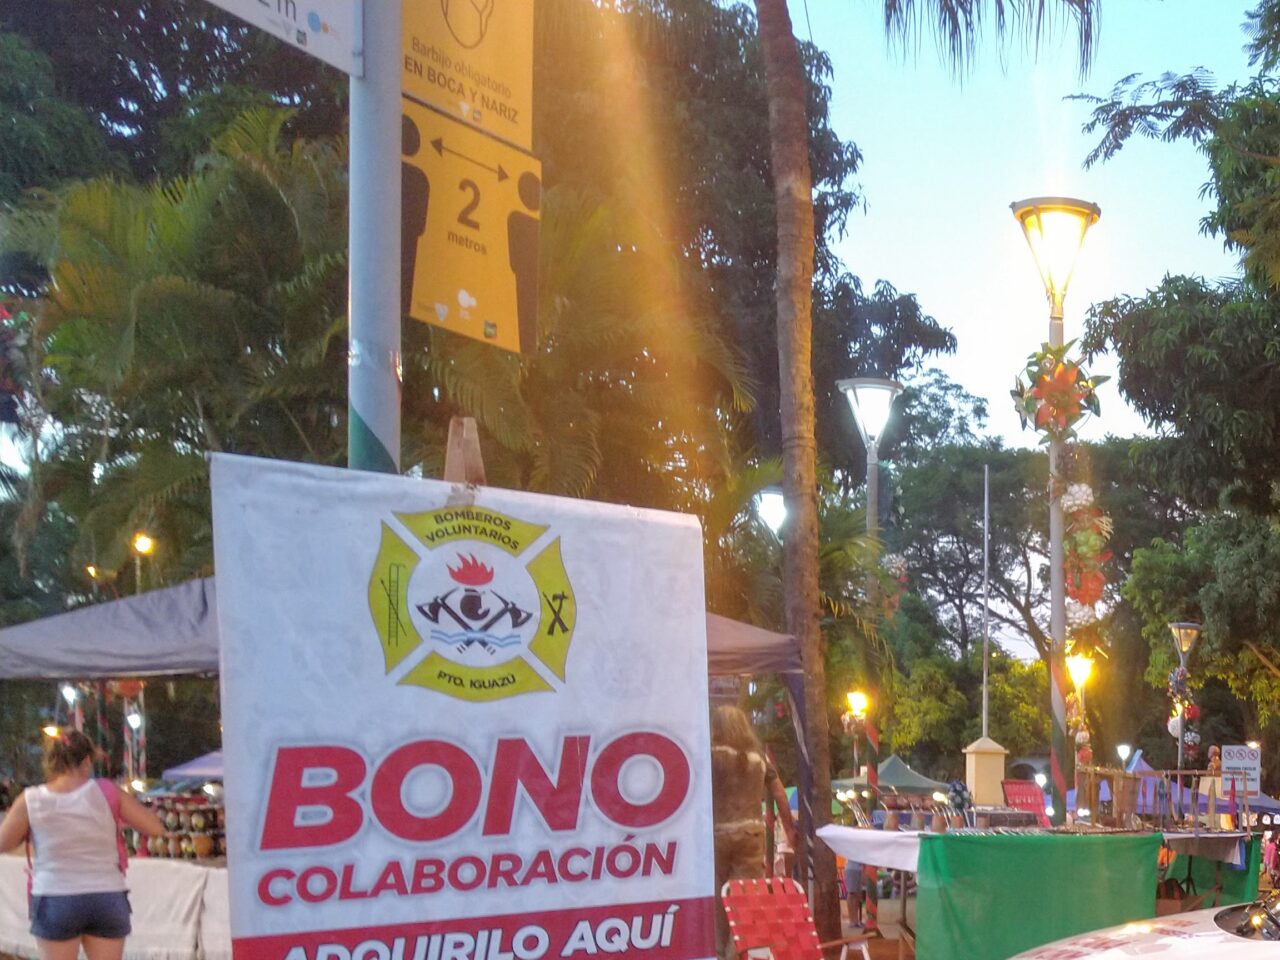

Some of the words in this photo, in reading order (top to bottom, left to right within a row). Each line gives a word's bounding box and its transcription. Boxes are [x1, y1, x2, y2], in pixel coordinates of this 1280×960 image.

[404, 54, 423, 78] EN
[427, 66, 466, 99] BOCA
[469, 86, 478, 103] Y
[481, 94, 519, 124] NARIZ
[412, 36, 452, 71] Barbijo
[454, 61, 512, 99] obligatorio
[457, 178, 481, 231] 2
[447, 229, 487, 255] metros
[426, 524, 520, 550] VOLUNTARIOS
[433, 510, 512, 531] BOMBEROS
[259, 731, 691, 851] BONO
[257, 834, 677, 906] COLABORACIÓN
[562, 904, 681, 955] AQUÍ
